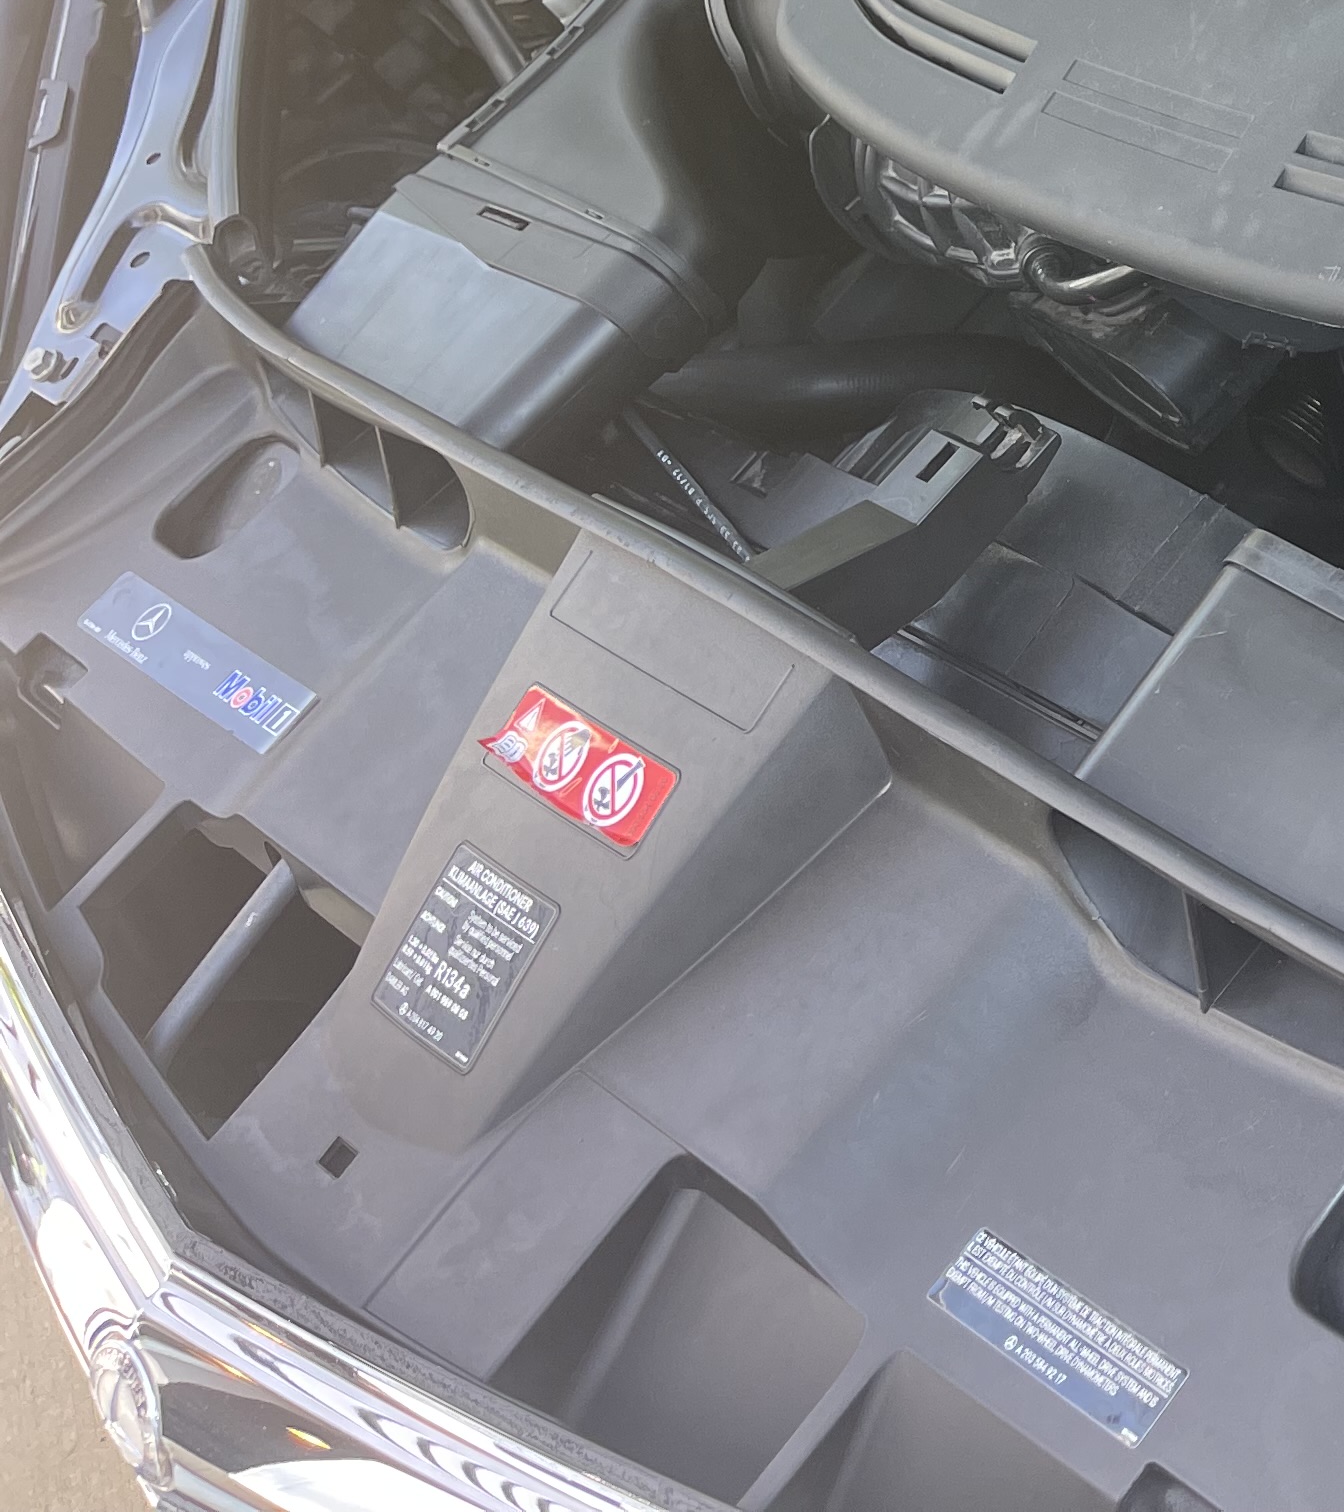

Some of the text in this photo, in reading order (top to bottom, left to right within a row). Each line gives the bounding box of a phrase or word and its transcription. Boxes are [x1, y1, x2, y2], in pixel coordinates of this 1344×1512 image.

[213, 669, 282, 724] Mobil
[445, 865, 499, 908] KLIMAANLAGE
[515, 914, 541, 939] 639)
[467, 859, 534, 912] AIR CONDITIONER
[431, 961, 475, 1000] R134a
[1019, 1347, 1036, 1364] 203
